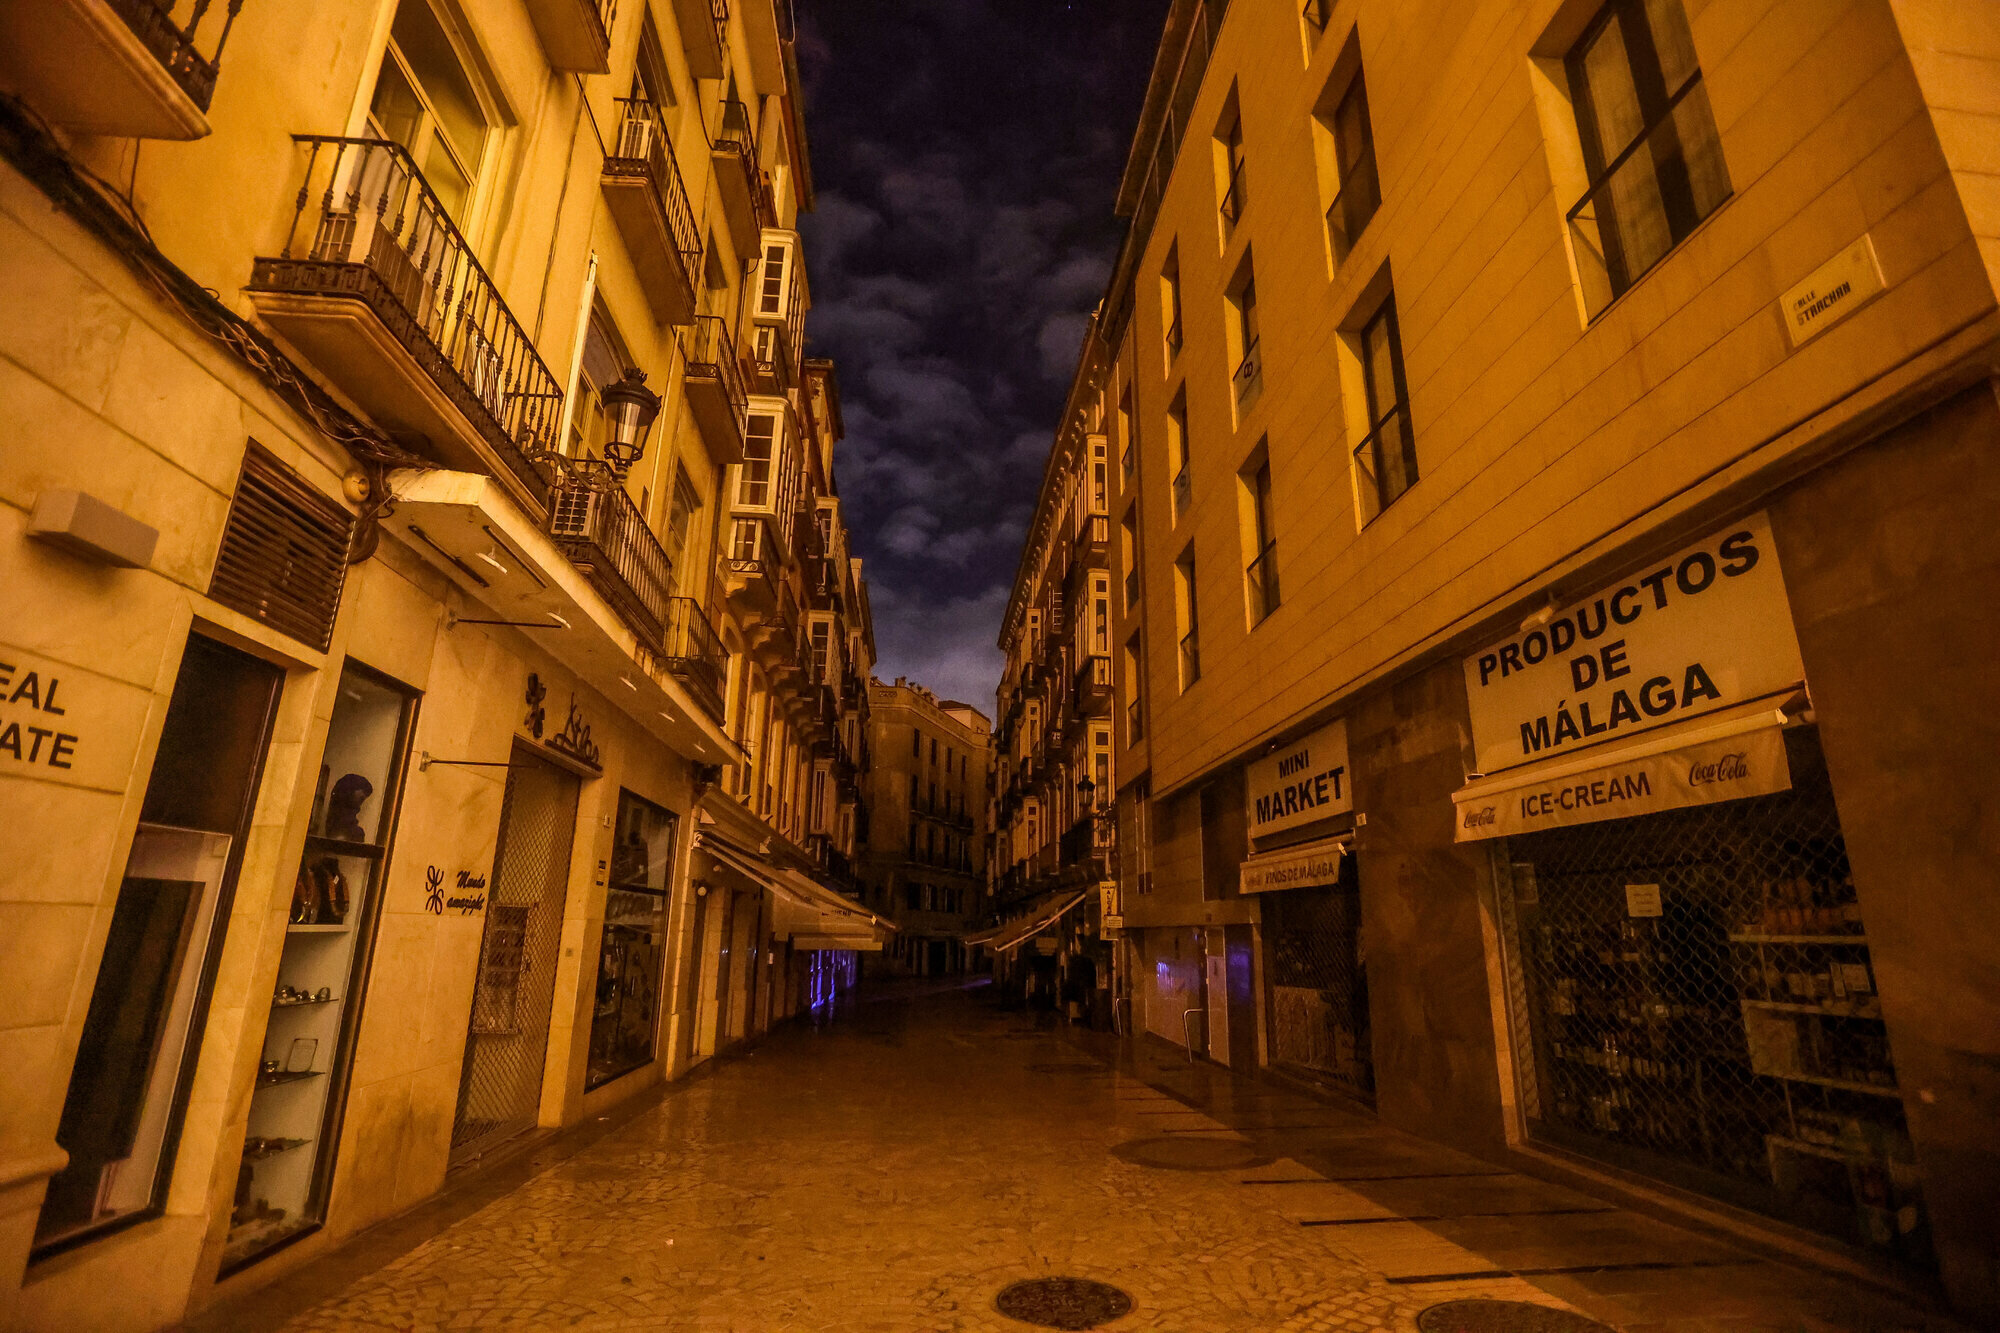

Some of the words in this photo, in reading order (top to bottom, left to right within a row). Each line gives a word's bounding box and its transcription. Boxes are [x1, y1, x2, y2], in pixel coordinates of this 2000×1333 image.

[1478, 530, 1760, 687] PRODUCTOS
[1570, 638, 1632, 693] DE
[1520, 662, 1722, 755] MÁLAGA
[0, 720, 79, 769] ATE
[1278, 749, 1310, 779] MINI
[1688, 752, 1749, 788] Coca-Cola
[1256, 765, 1345, 825] MARKET
[1521, 771, 1651, 819] ICE-CREAM
[1265, 868, 1287, 884] VINOS
[1287, 867, 1298, 881] DE
